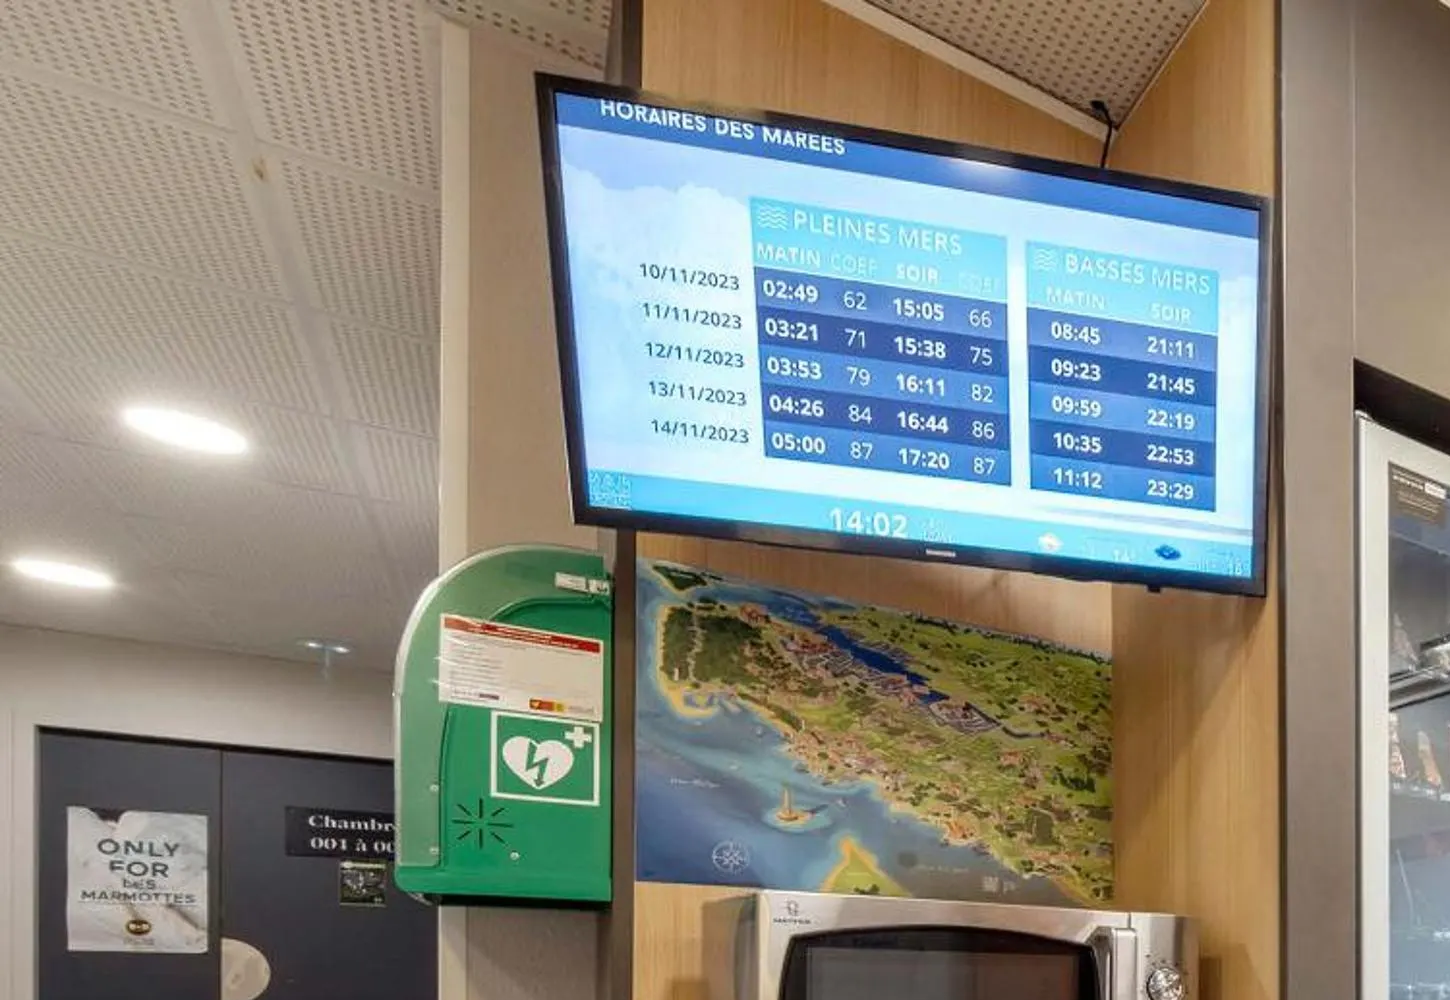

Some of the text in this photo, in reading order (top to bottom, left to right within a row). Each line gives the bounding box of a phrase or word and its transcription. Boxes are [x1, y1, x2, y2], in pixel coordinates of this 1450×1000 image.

[600, 100, 846, 155] HORAIRES DES MAREES
[793, 209, 963, 255] PLEINES MERS
[639, 262, 740, 291] 10/11/2023
[756, 243, 821, 268] MATIN
[896, 261, 939, 284] SOIR
[1065, 253, 1212, 296] BASSES MERS
[642, 302, 743, 330] 11/11/2023
[762, 279, 993, 328] 02:49 62 15:05 66
[1046, 285, 1192, 325] MATIN SOIR
[645, 341, 745, 369] 12/11/2023
[764, 317, 993, 367] 03:21 71 15:38 75
[1051, 320, 1195, 359] 08:45 21:11
[648, 380, 748, 407] 13/11/2023
[766, 356, 993, 403] 03:53 79 16:11 82
[1051, 358, 1195, 395] 09:23 21:45
[769, 394, 995, 440] 04:26 84 16:44 86
[1051, 394, 1195, 431] 09:59 22:19
[651, 419, 750, 445] 14/11/2023
[1053, 431, 1195, 466] 10:35 22:53
[771, 432, 996, 475] 05:00 87 17:20 87
[1053, 467, 1194, 500] 11:12 23:29
[830, 506, 909, 539] 14:02
[308, 814, 395, 832] Chambr
[97, 838, 180, 857] ONLY
[310, 836, 395, 853] 001 à 00
[108, 860, 170, 878] FOR
[81, 889, 197, 904] MARMOTTES
